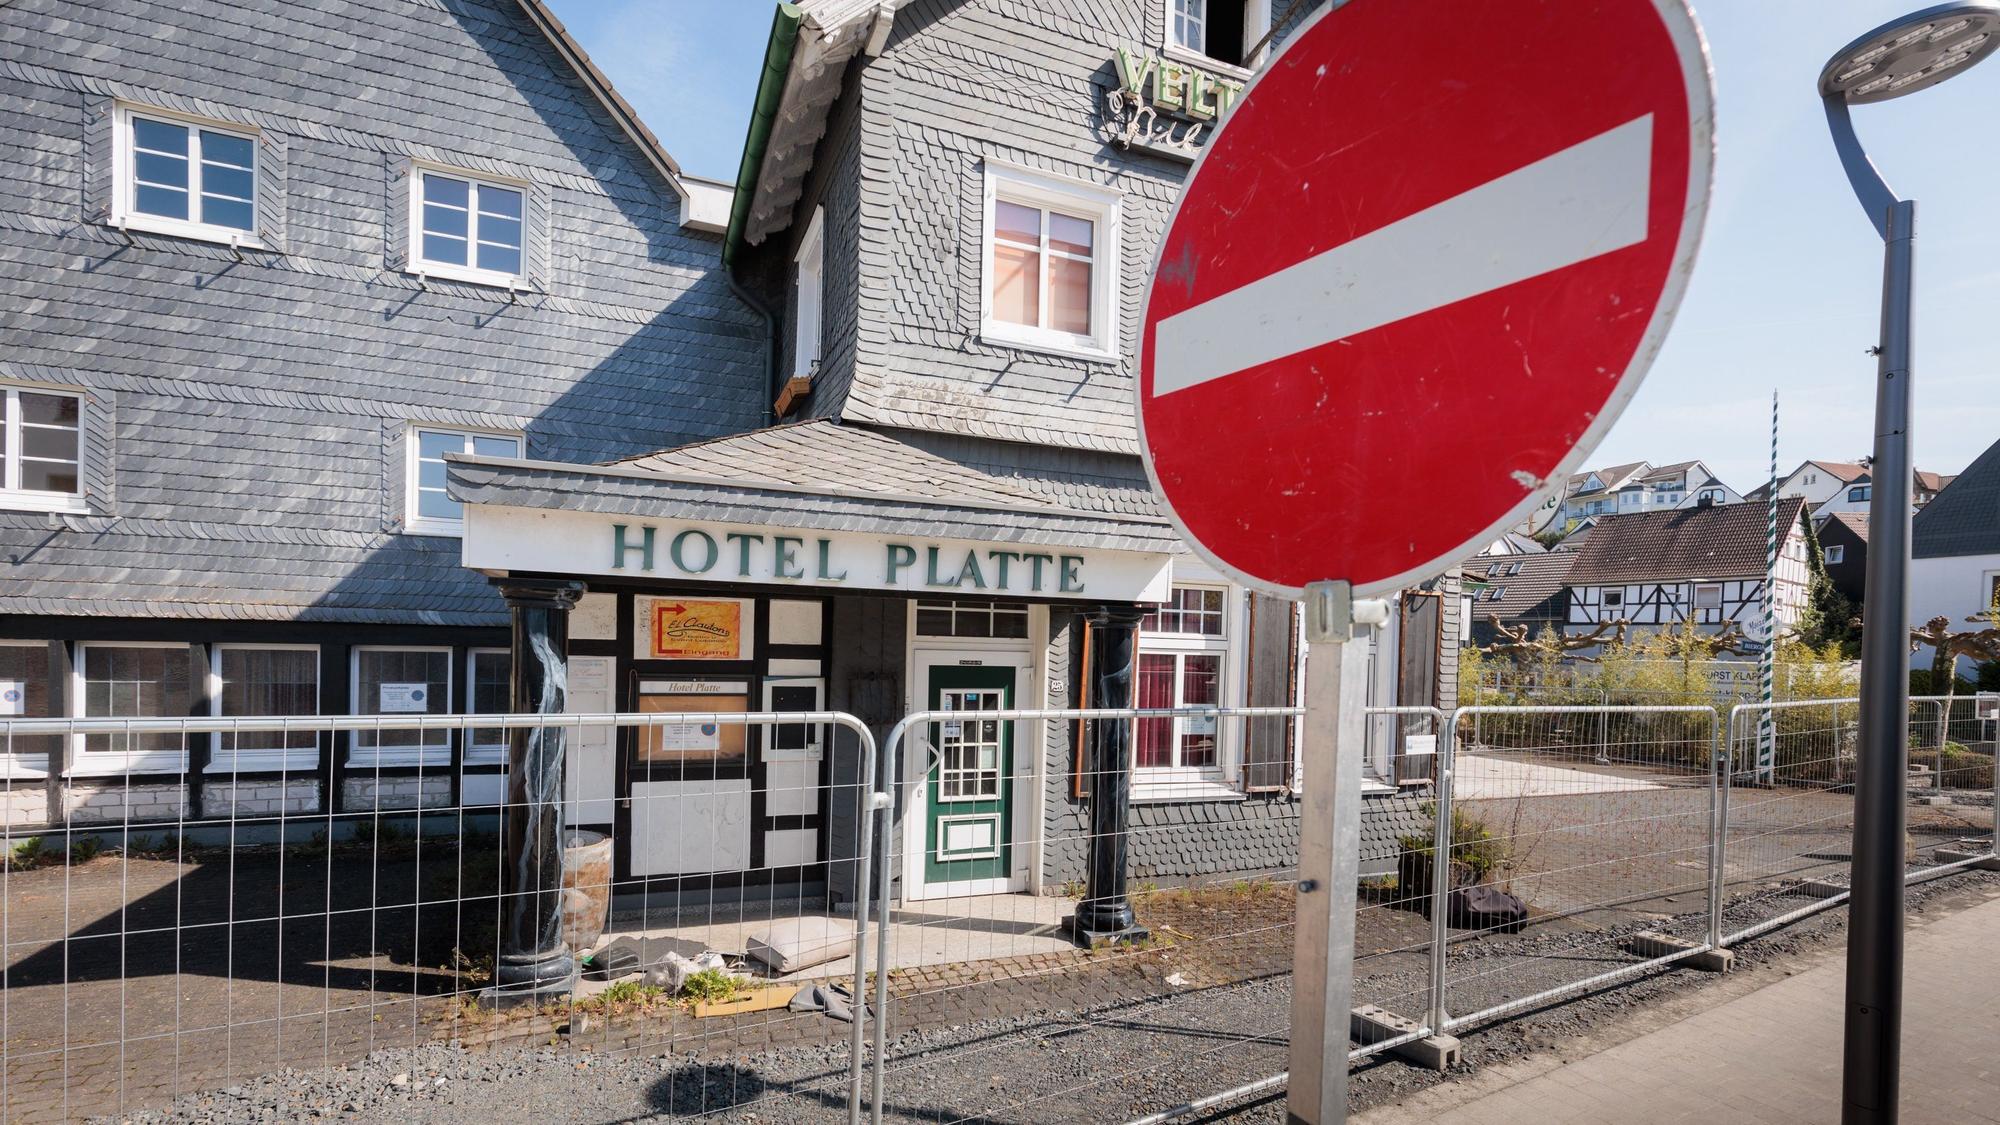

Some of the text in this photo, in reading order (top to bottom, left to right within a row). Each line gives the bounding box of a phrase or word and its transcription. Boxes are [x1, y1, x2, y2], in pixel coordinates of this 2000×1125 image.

[612, 524, 1084, 593] HOTEL PLATTE
[669, 683, 720, 692] Hotel Platte
